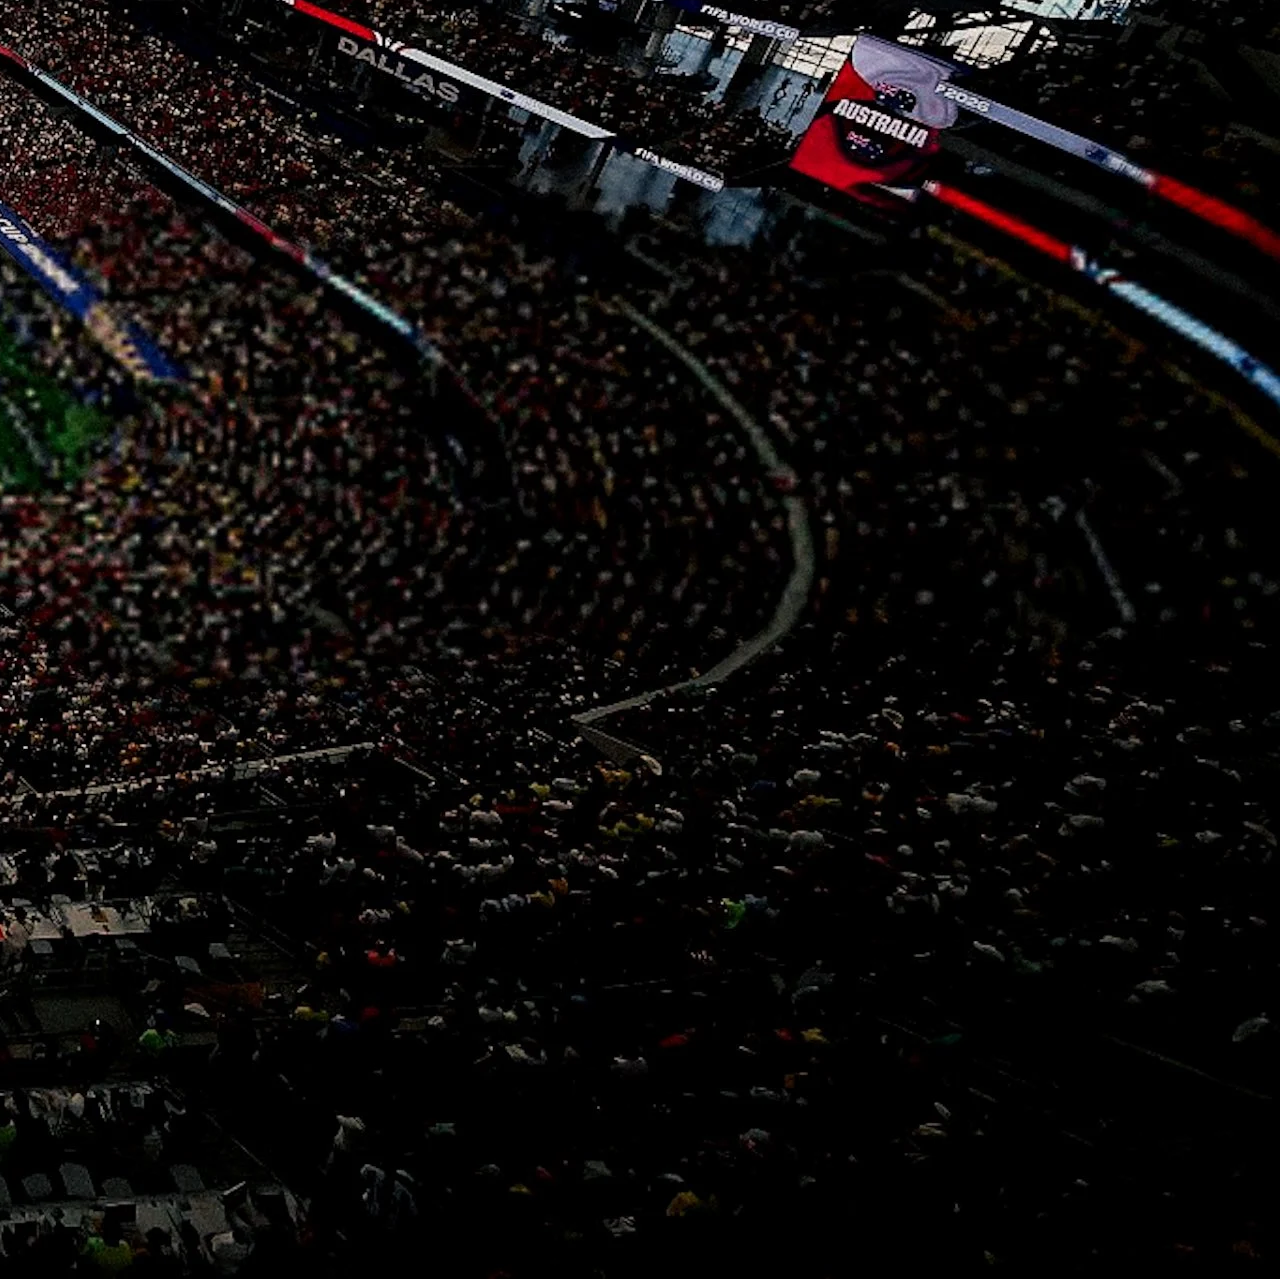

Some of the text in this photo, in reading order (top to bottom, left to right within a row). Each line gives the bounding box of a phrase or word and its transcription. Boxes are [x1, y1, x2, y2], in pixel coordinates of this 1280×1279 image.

[729, 12, 775, 33] WORLD
[338, 36, 460, 103] DALLAS
[832, 99, 929, 148] AUSTRALIA
